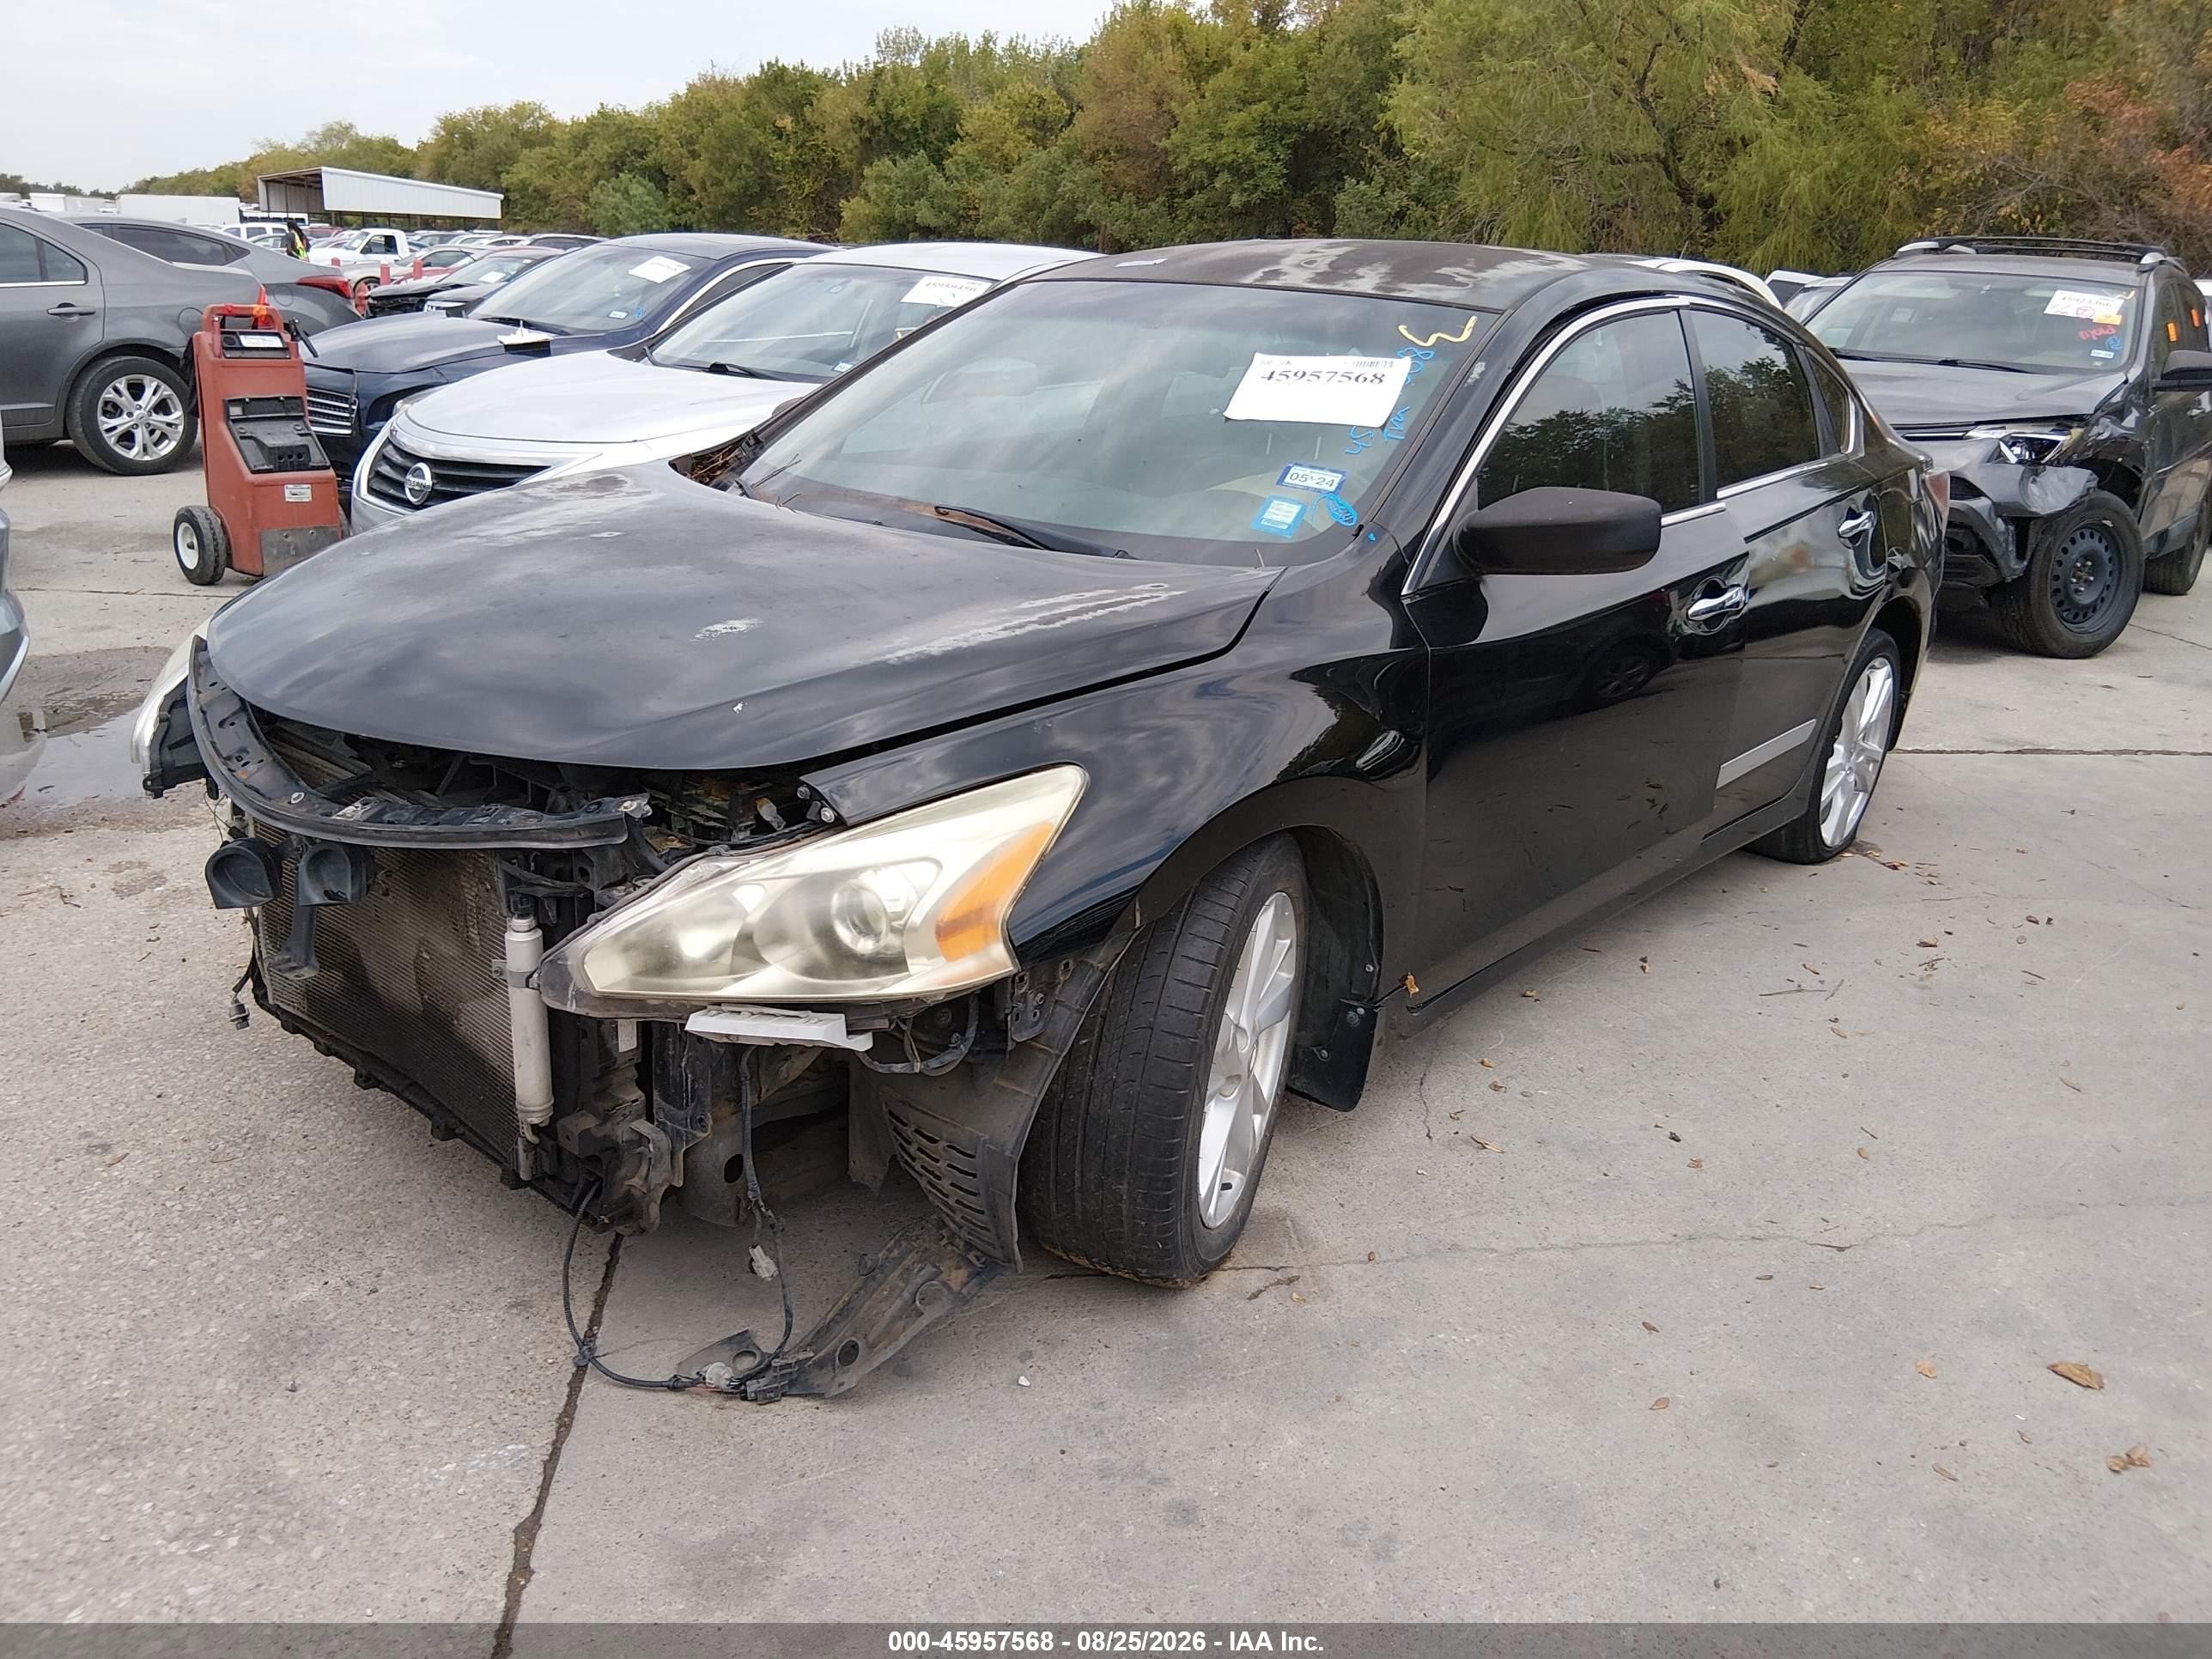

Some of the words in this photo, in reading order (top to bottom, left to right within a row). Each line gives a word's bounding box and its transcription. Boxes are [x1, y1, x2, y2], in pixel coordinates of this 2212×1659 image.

[1261, 370, 1386, 385] 45957568
[1290, 472, 1310, 483] 05
[1315, 477, 1335, 488] 24
